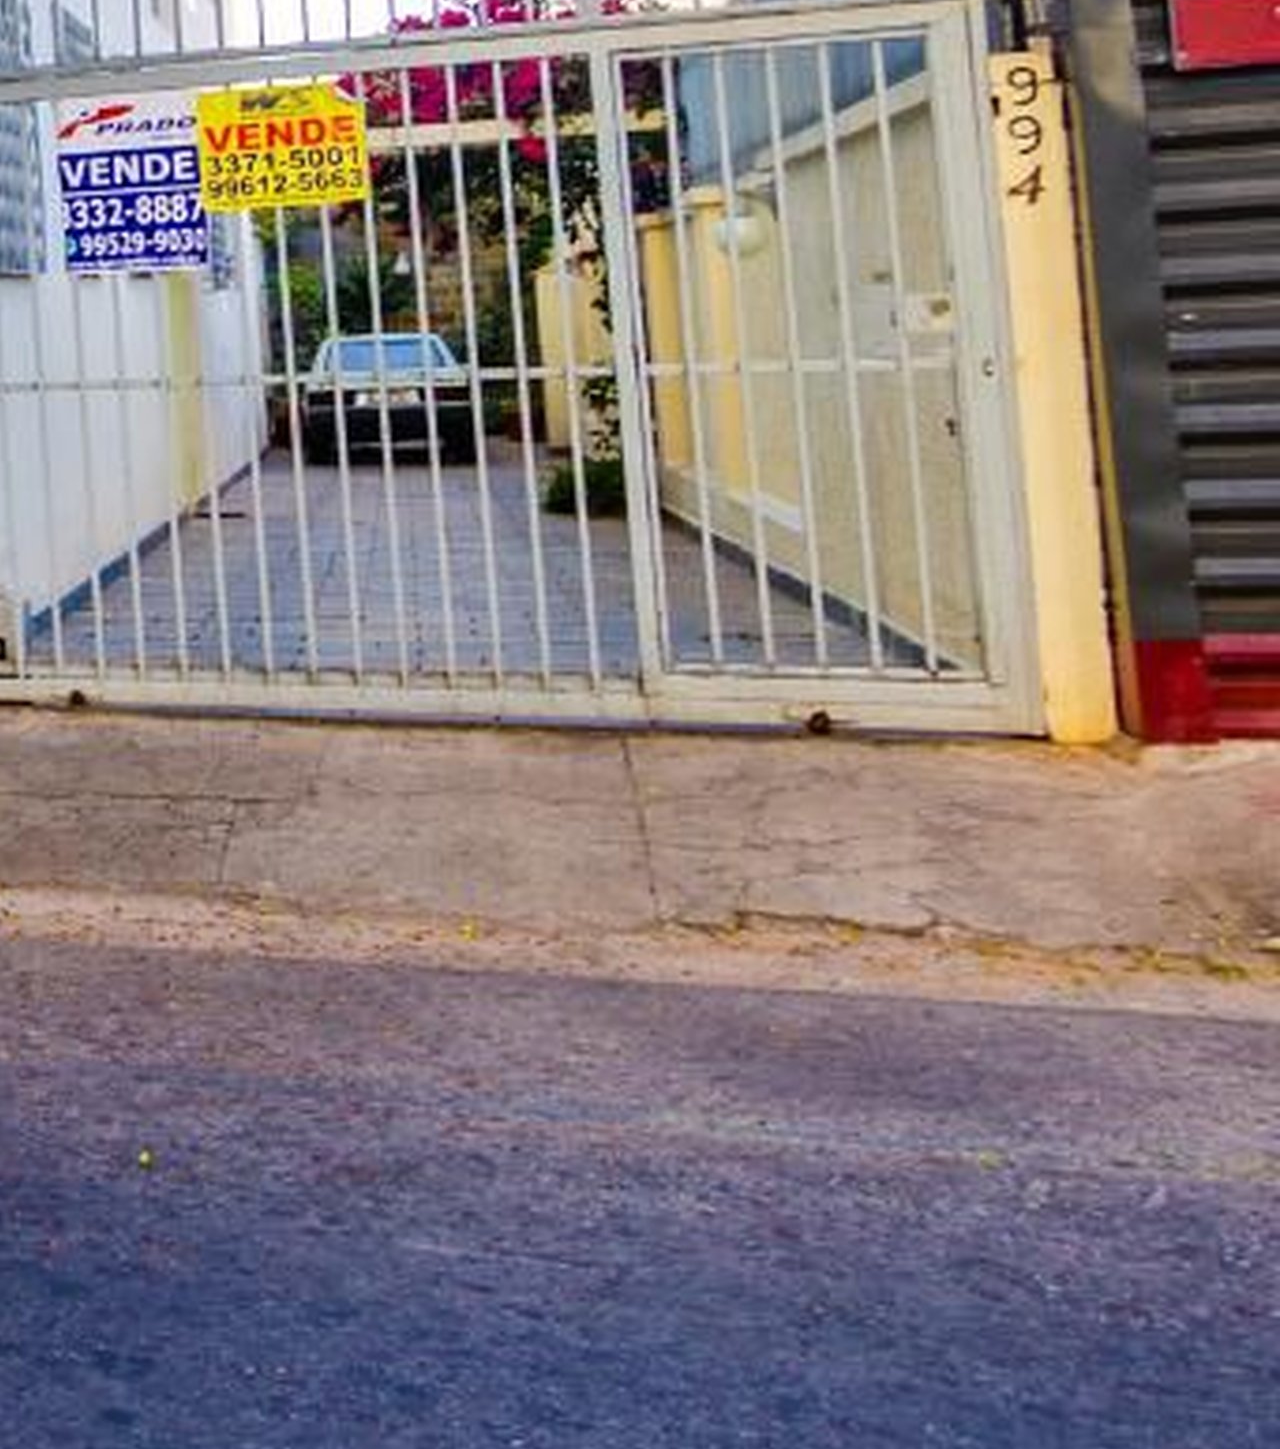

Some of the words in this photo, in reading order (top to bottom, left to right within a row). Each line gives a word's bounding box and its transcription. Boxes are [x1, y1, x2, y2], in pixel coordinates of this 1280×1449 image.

[95, 114, 197, 135] PRADO
[203, 115, 357, 152] VENDE
[1006, 66, 1046, 205] 994
[60, 150, 197, 189] VENDE
